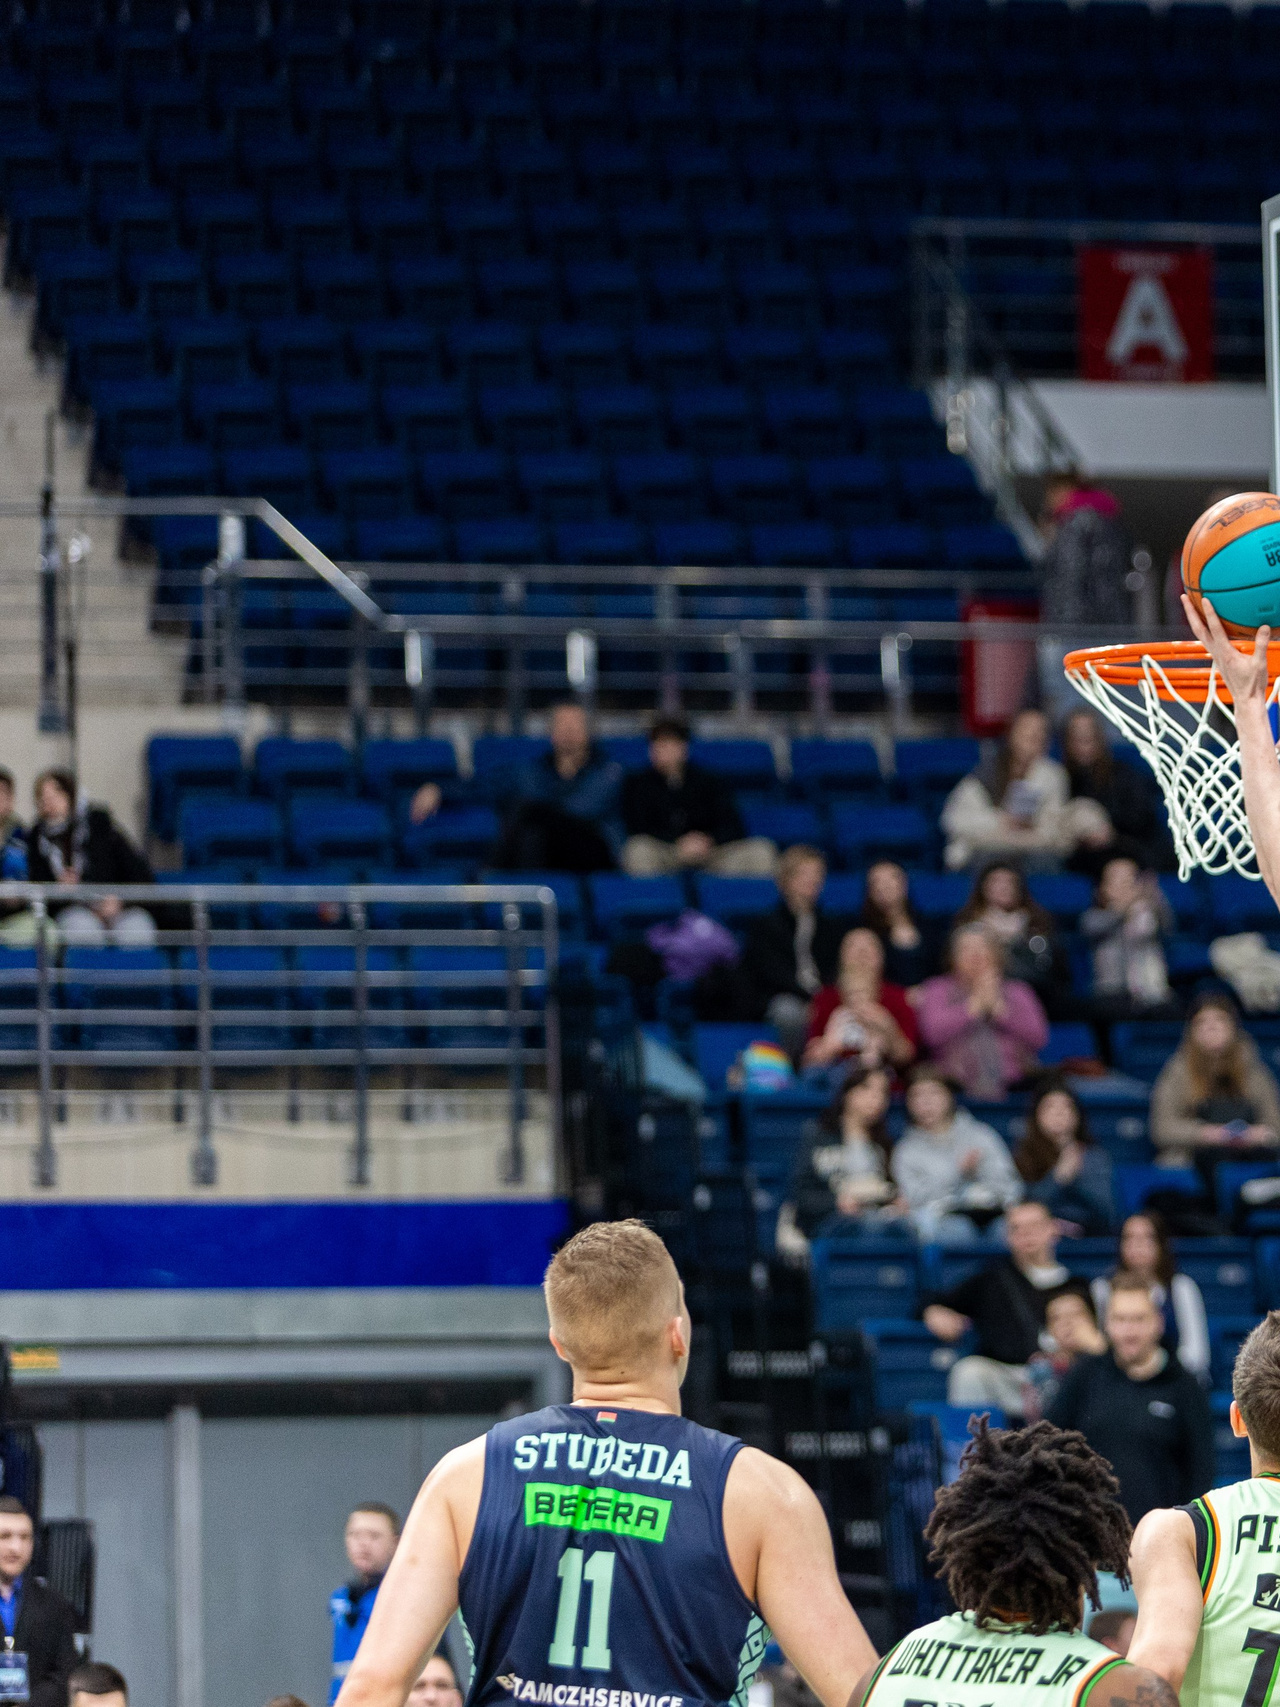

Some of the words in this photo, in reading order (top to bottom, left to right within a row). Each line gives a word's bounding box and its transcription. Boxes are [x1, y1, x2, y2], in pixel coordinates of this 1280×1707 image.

[1104, 275, 1188, 365] A
[514, 1433, 691, 1487] STUBEDA
[534, 1492, 660, 1531] BETERA
[548, 1548, 615, 1671] 11
[887, 1638, 1044, 1685] WHITTAKER
[1036, 1653, 1091, 1687] JR
